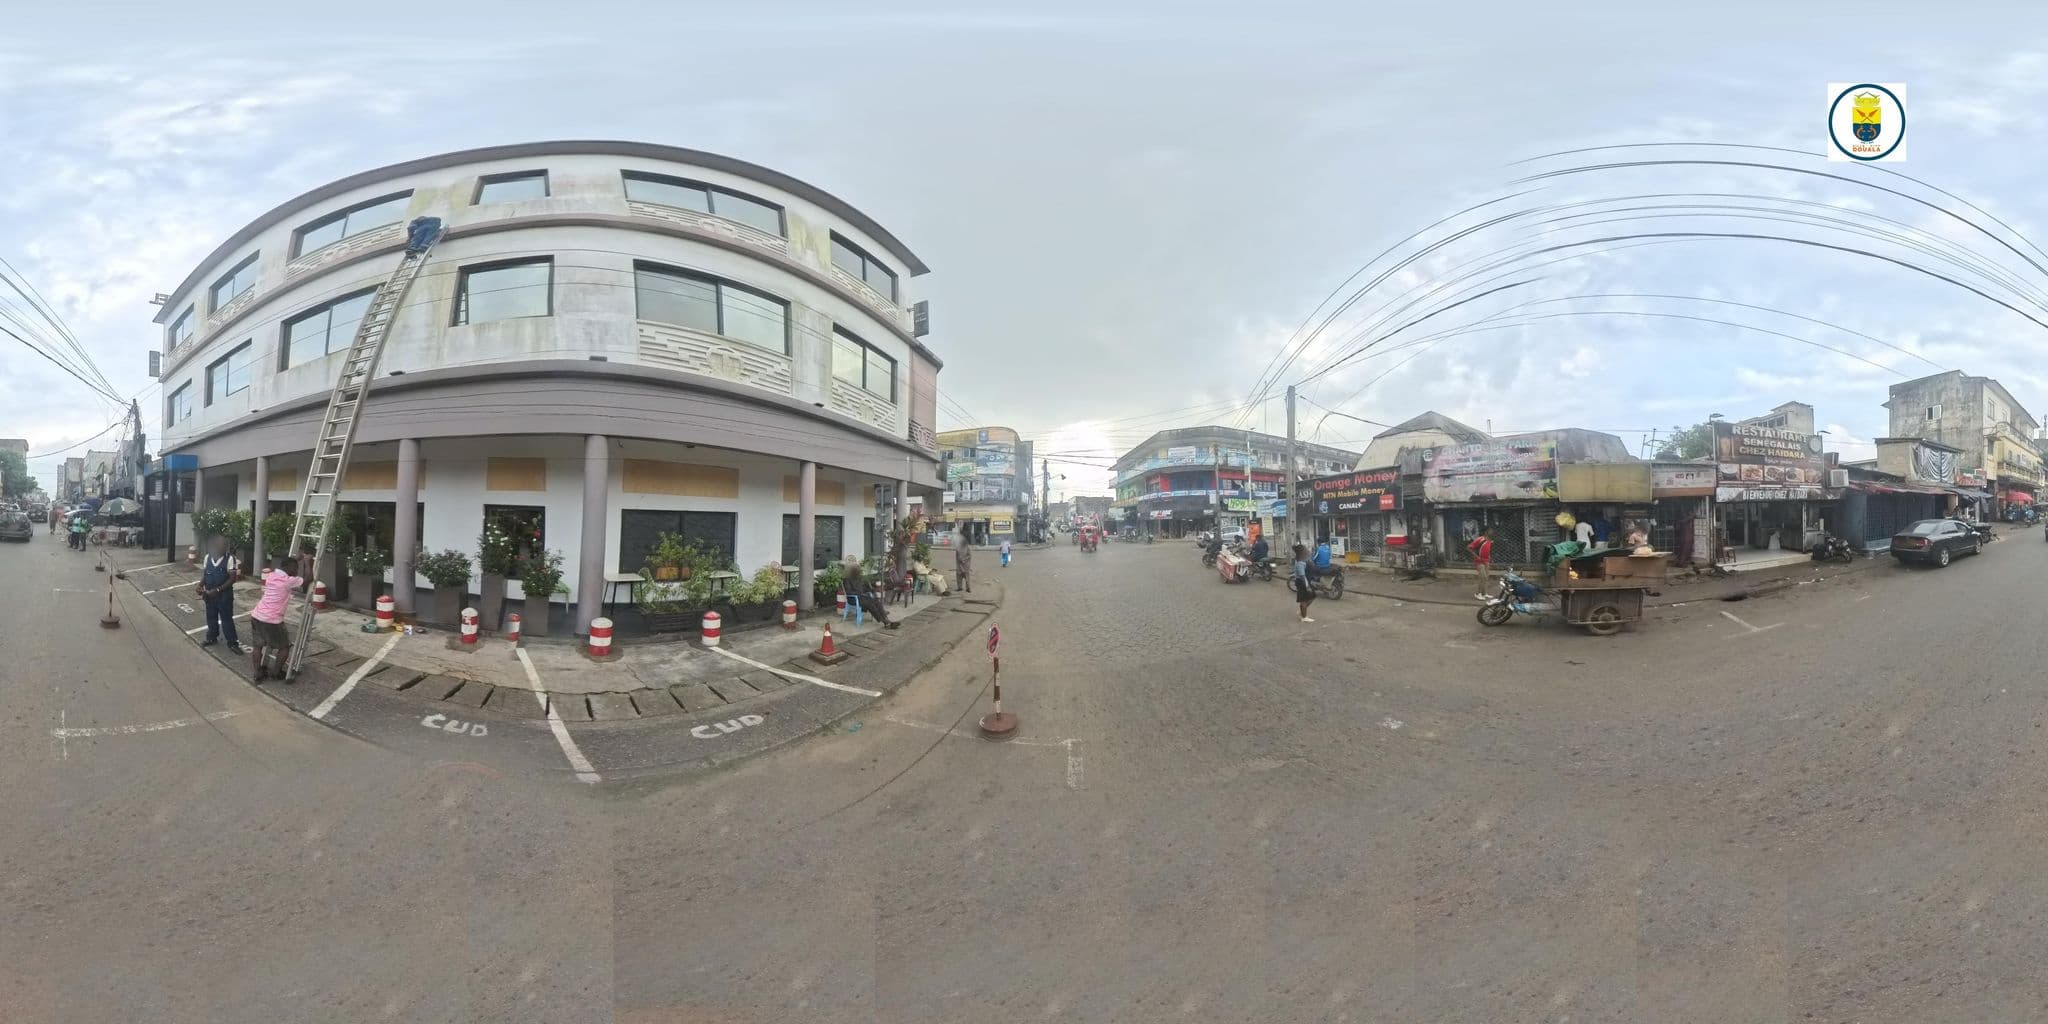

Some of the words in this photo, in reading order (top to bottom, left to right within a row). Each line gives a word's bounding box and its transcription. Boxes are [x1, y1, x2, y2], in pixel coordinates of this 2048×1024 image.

[1733, 426, 1807, 442] RESTAURANT
[1740, 446, 1766, 456] CHEZ
[1768, 449, 1806, 460] HAIDARA
[1314, 479, 1351, 491] Orange
[1355, 471, 1397, 484] Money
[1323, 491, 1336, 499] MTN
[1337, 489, 1359, 498] Mobile
[1360, 487, 1386, 497] Money
[421, 713, 489, 737] CUD
[690, 714, 764, 739] CUD
